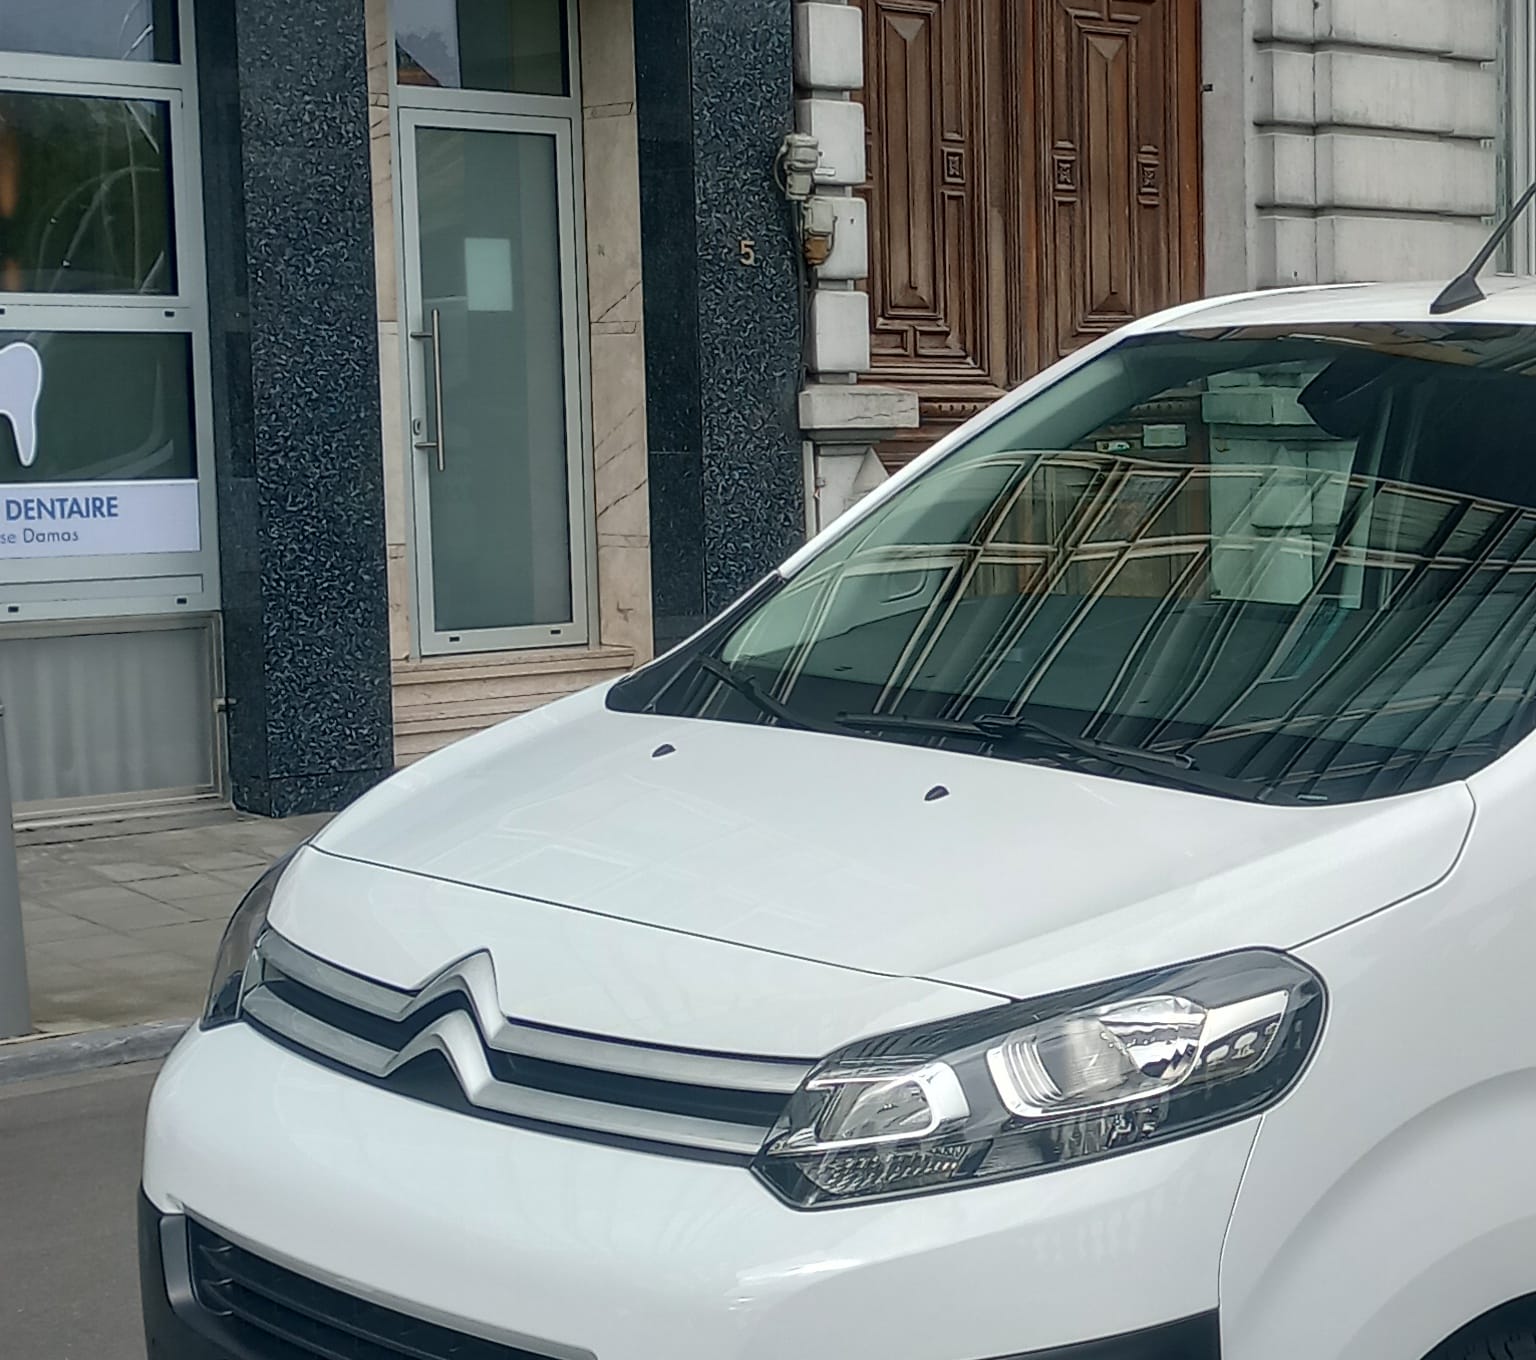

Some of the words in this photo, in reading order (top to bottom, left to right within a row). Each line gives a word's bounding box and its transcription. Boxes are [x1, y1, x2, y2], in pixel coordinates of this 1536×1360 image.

[740, 240, 755, 266] 5
[5, 496, 118, 520] DENTAIRE
[23, 528, 79, 543] Damas
